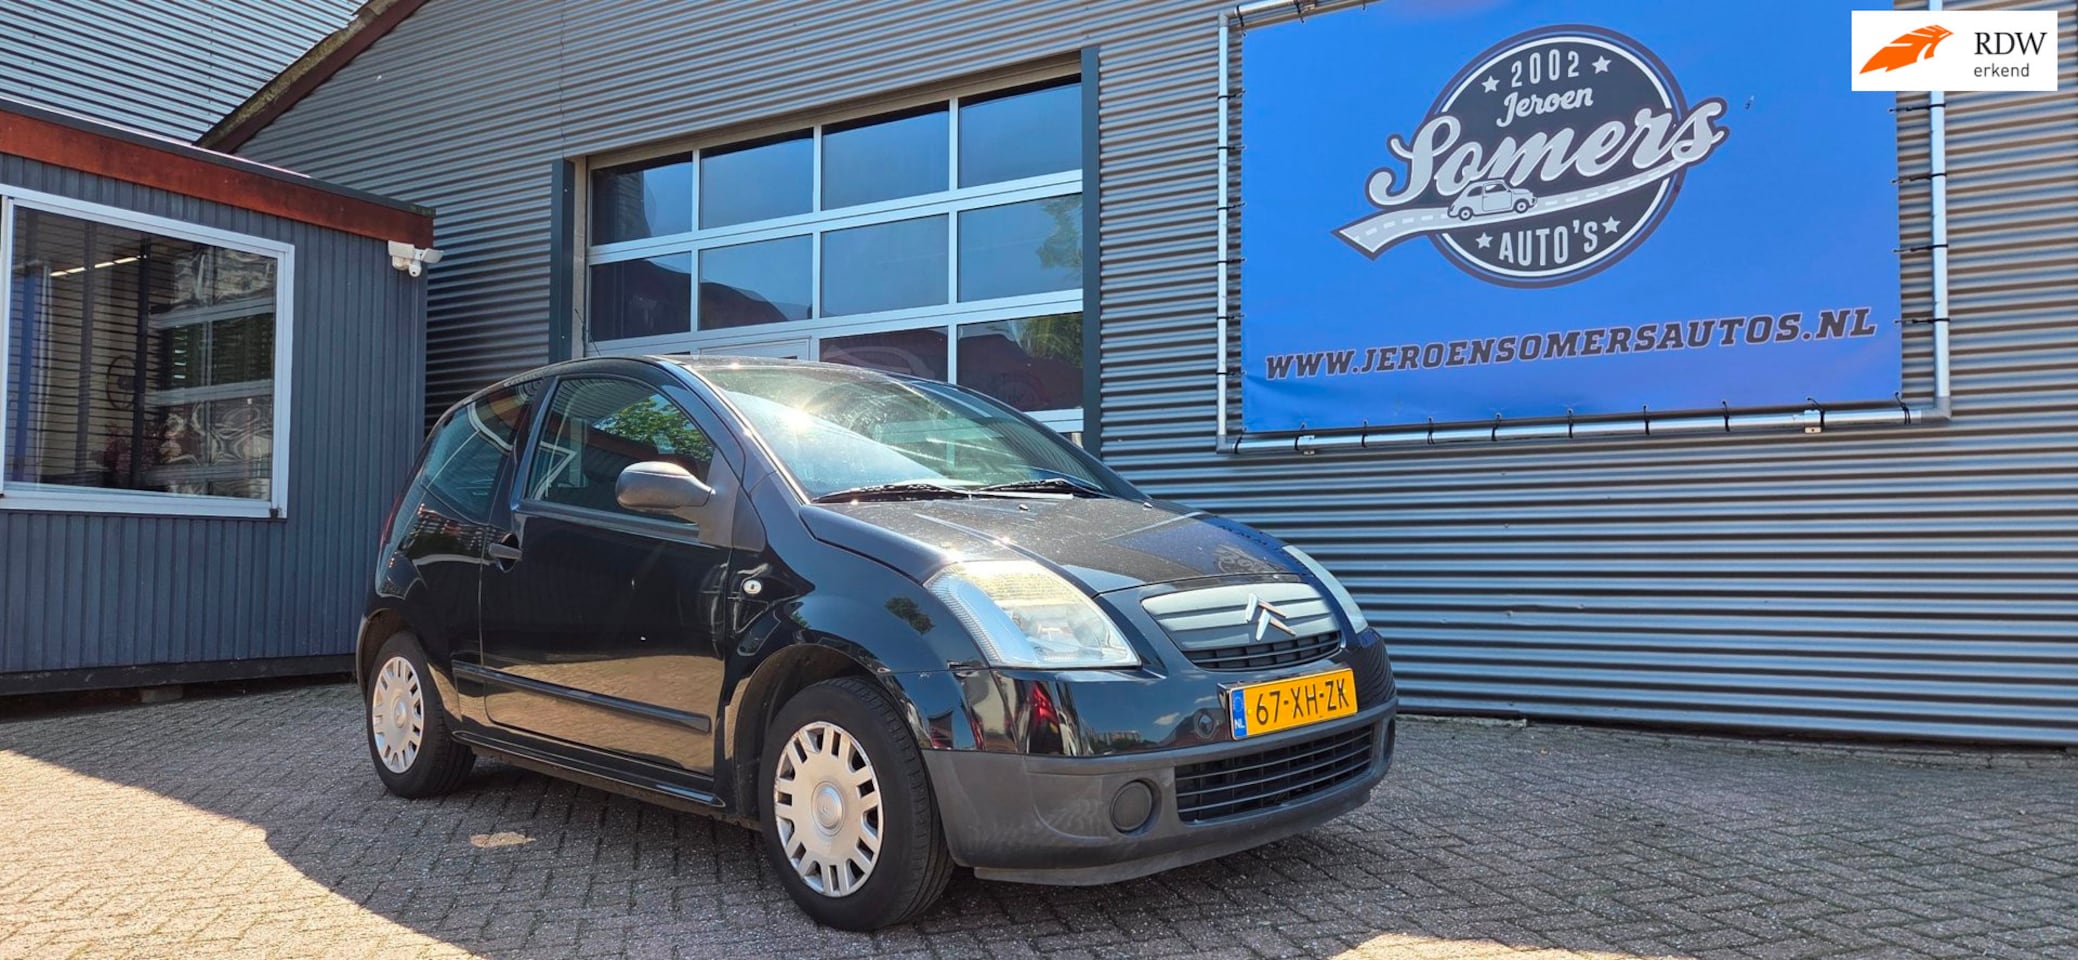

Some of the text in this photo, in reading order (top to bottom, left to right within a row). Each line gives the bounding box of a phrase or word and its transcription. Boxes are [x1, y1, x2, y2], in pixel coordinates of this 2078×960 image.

[1511, 49, 1580, 88] 2002
[1496, 87, 1593, 128] Jeroen
[1369, 102, 1725, 206] Somers
[1499, 219, 1598, 266] AUTO'S
[1265, 306, 1876, 380] WWW.JEROENSOMERSAUTOS.NL
[1234, 718, 1245, 729] NL
[1256, 678, 1350, 725] 67-XH-ZK
